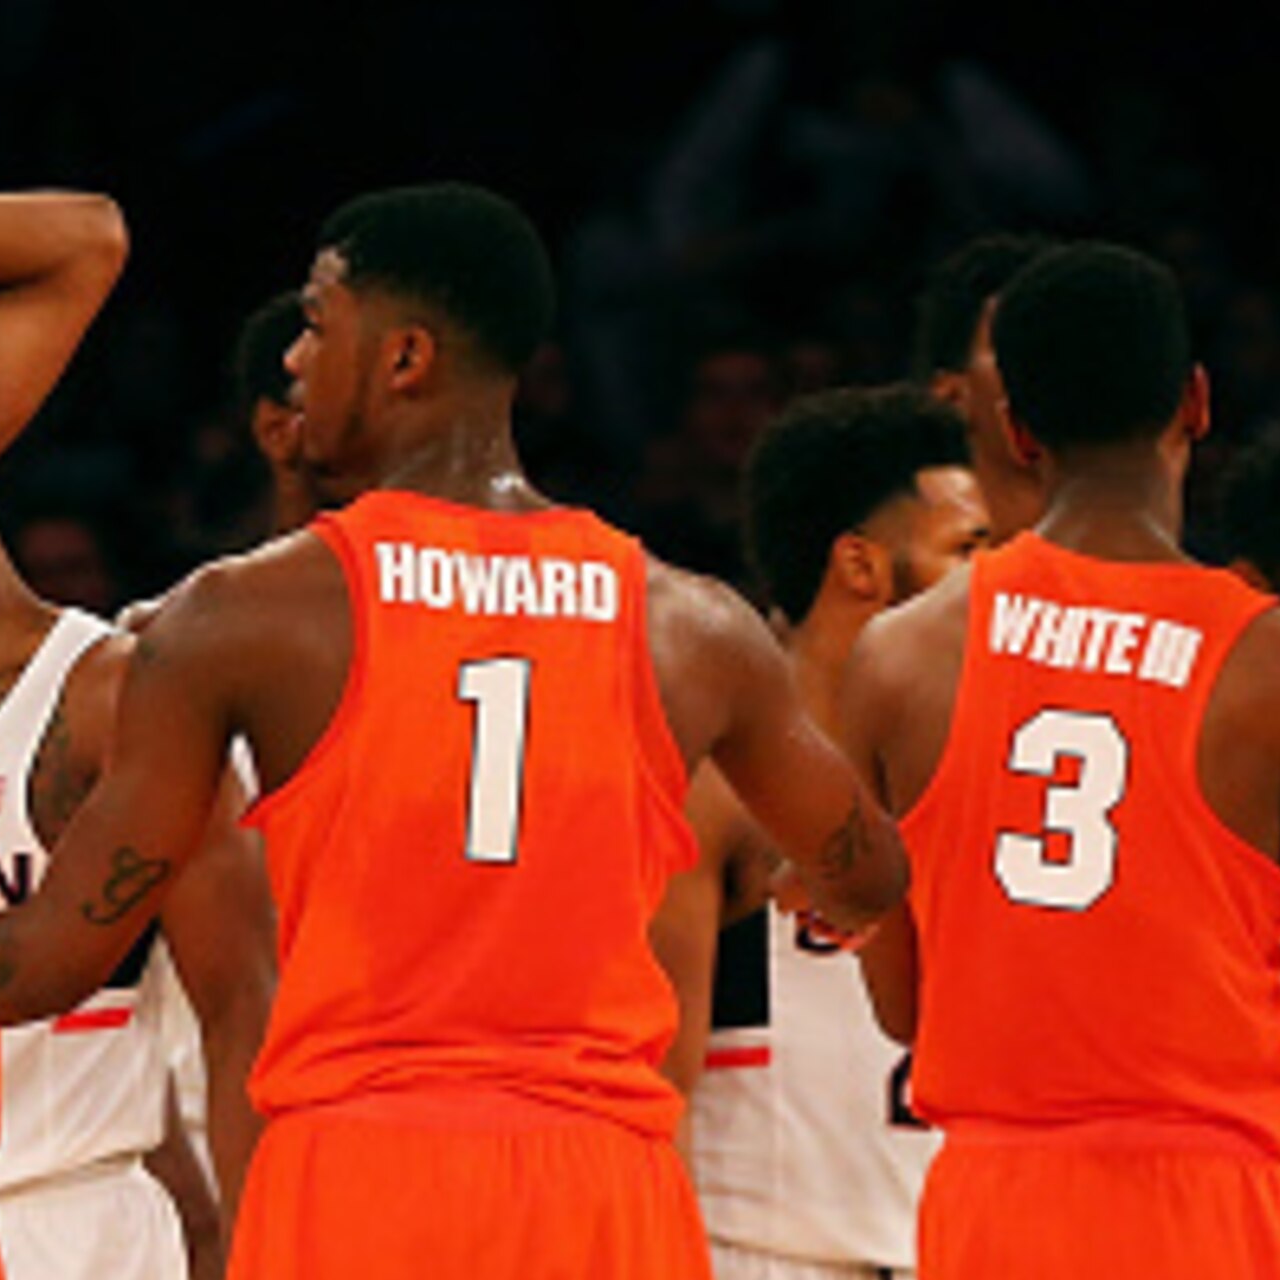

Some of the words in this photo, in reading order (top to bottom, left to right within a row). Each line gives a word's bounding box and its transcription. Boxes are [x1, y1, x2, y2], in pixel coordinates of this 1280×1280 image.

[373, 541, 619, 622] HOWARD
[989, 593, 1147, 674] WHITE
[1138, 618, 1204, 689] III
[456, 656, 532, 863] 1
[993, 706, 1131, 912] 3
